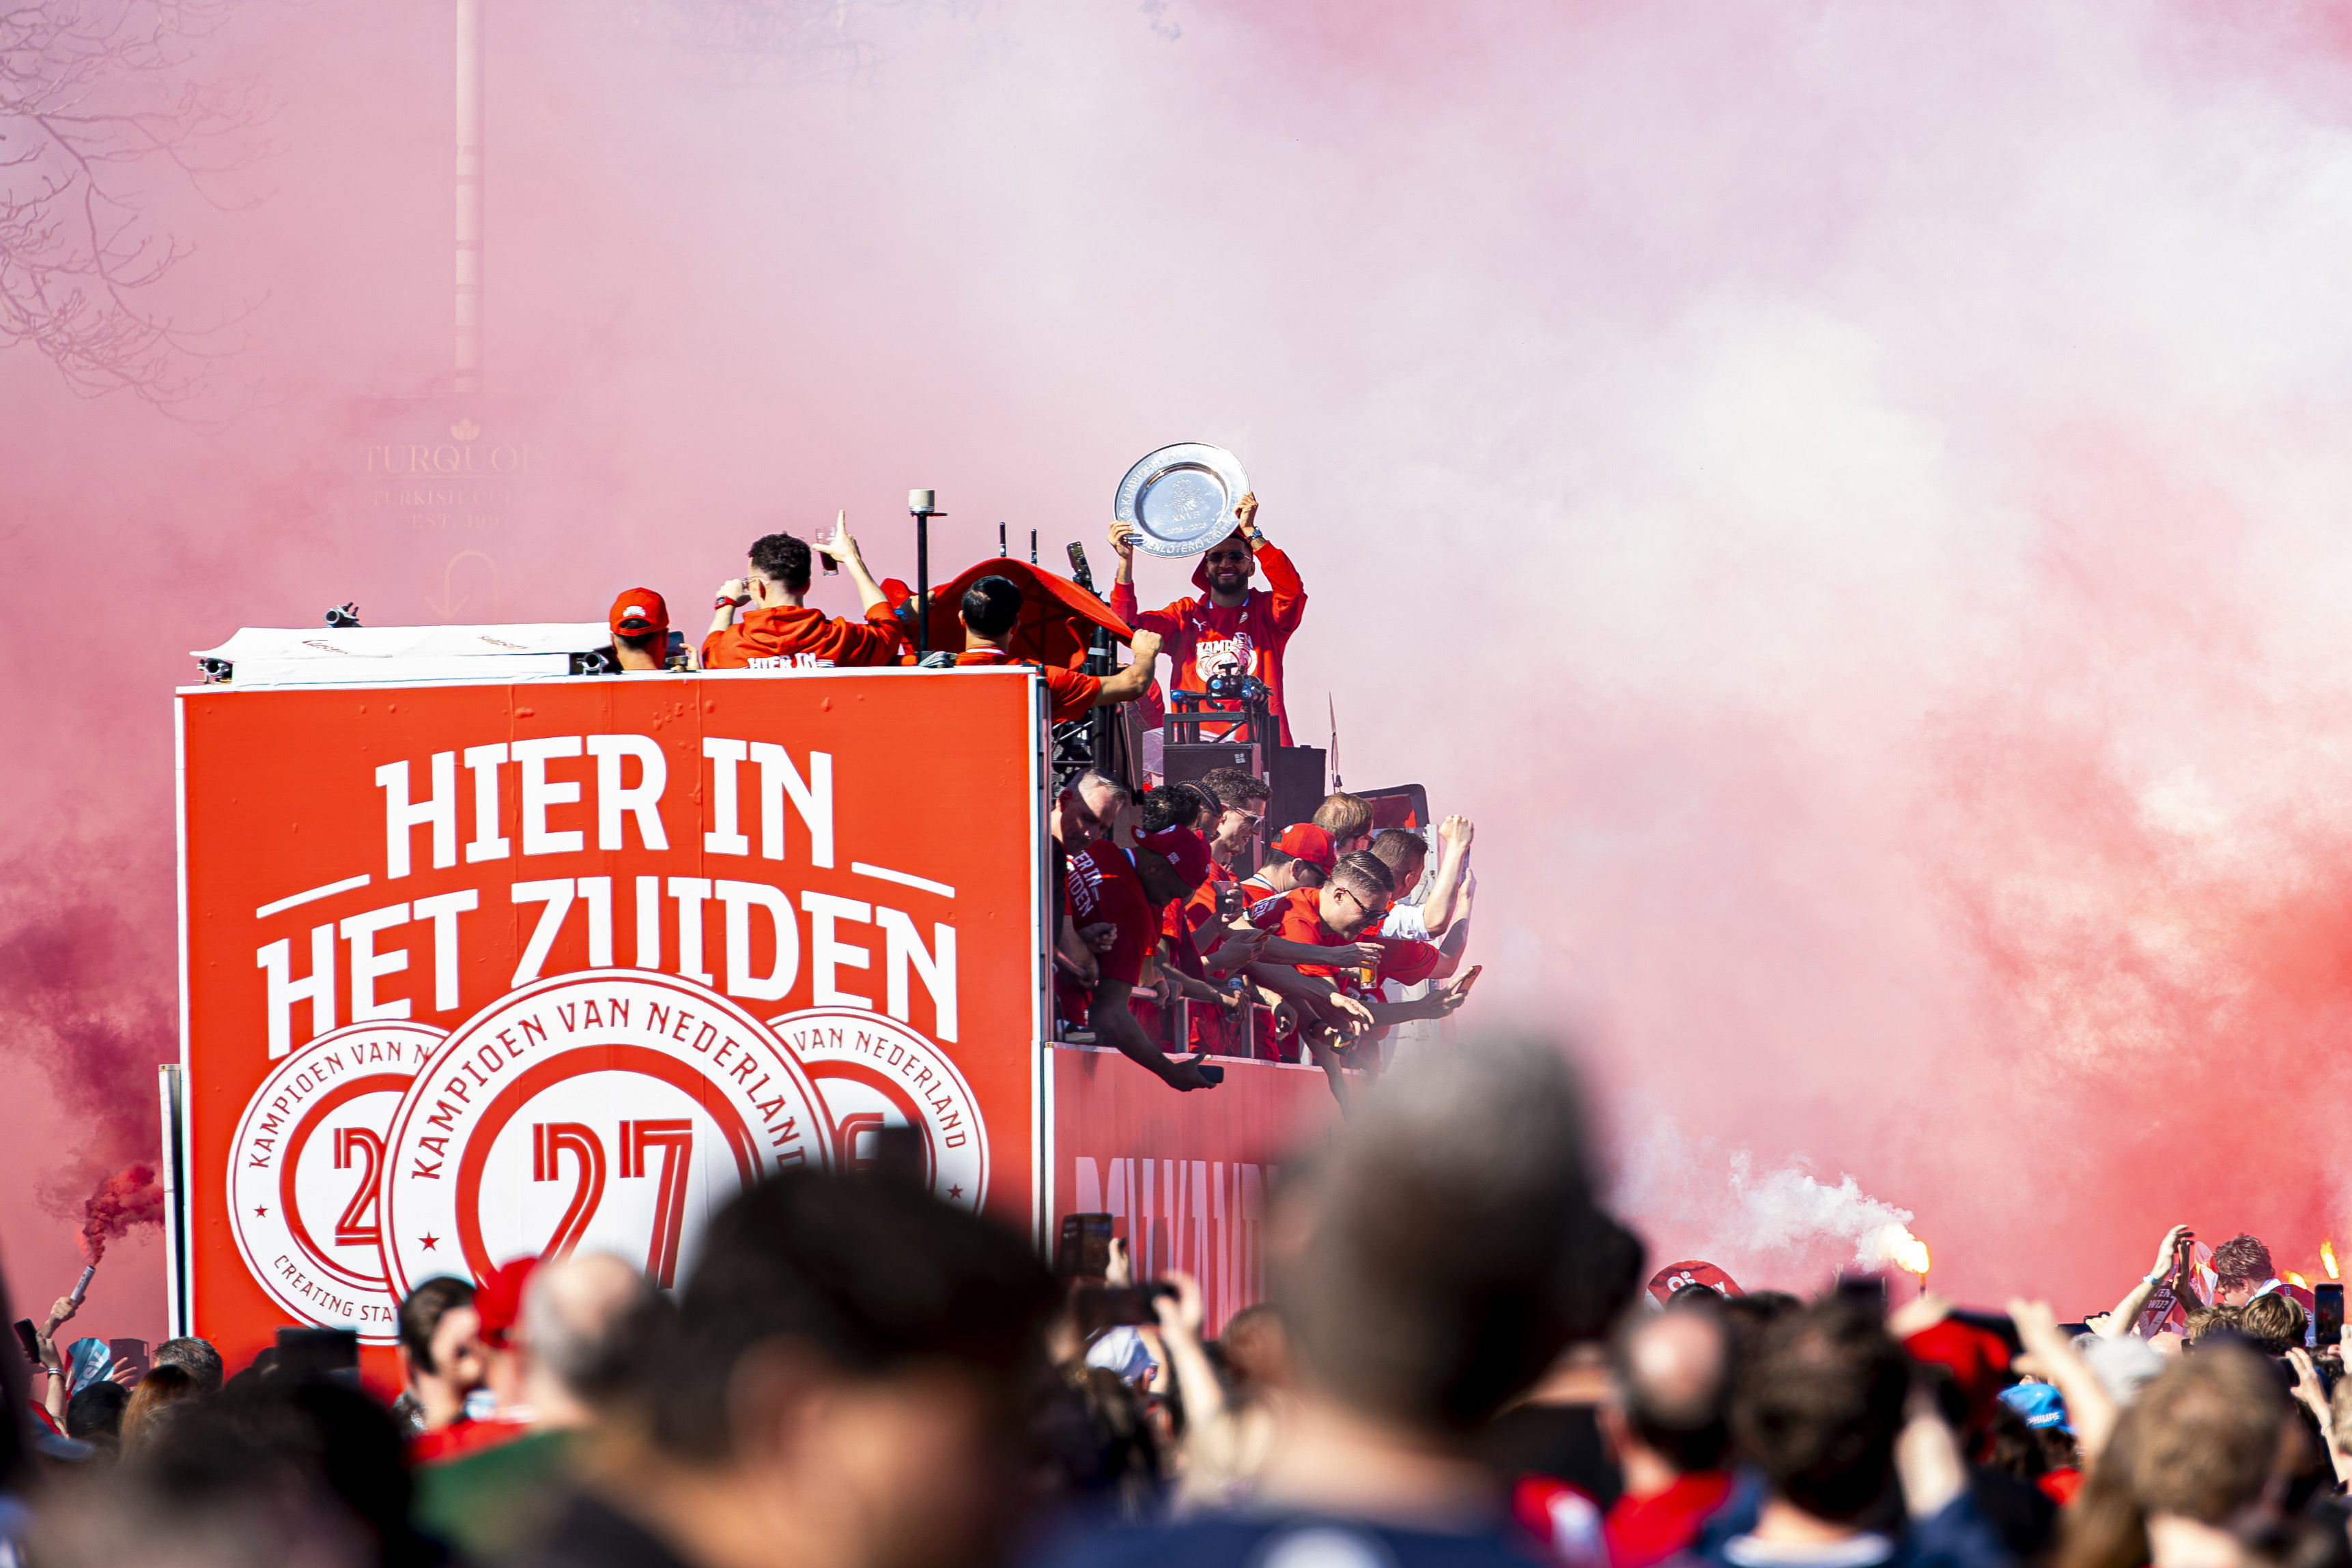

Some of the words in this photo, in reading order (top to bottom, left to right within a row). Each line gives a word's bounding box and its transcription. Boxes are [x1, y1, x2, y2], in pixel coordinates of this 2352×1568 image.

[374, 734, 669, 879] HIER
[703, 737, 834, 870] IN
[256, 887, 479, 1059] HET
[510, 875, 958, 1044] ZUIDEN
[249, 1051, 345, 1169] KAMPIOEN
[350, 1041, 401, 1065] VAN
[410, 1013, 549, 1180] KAMPIOEN
[557, 997, 631, 1032] VAN
[646, 1001, 808, 1169] NEDERLAND
[793, 1027, 843, 1052] VAN
[855, 1030, 967, 1150] NEDERLAND
[332, 1127, 384, 1246] 2
[533, 1118, 694, 1290] 27
[274, 1254, 353, 1317] CREATING
[360, 1305, 399, 1322] STA
